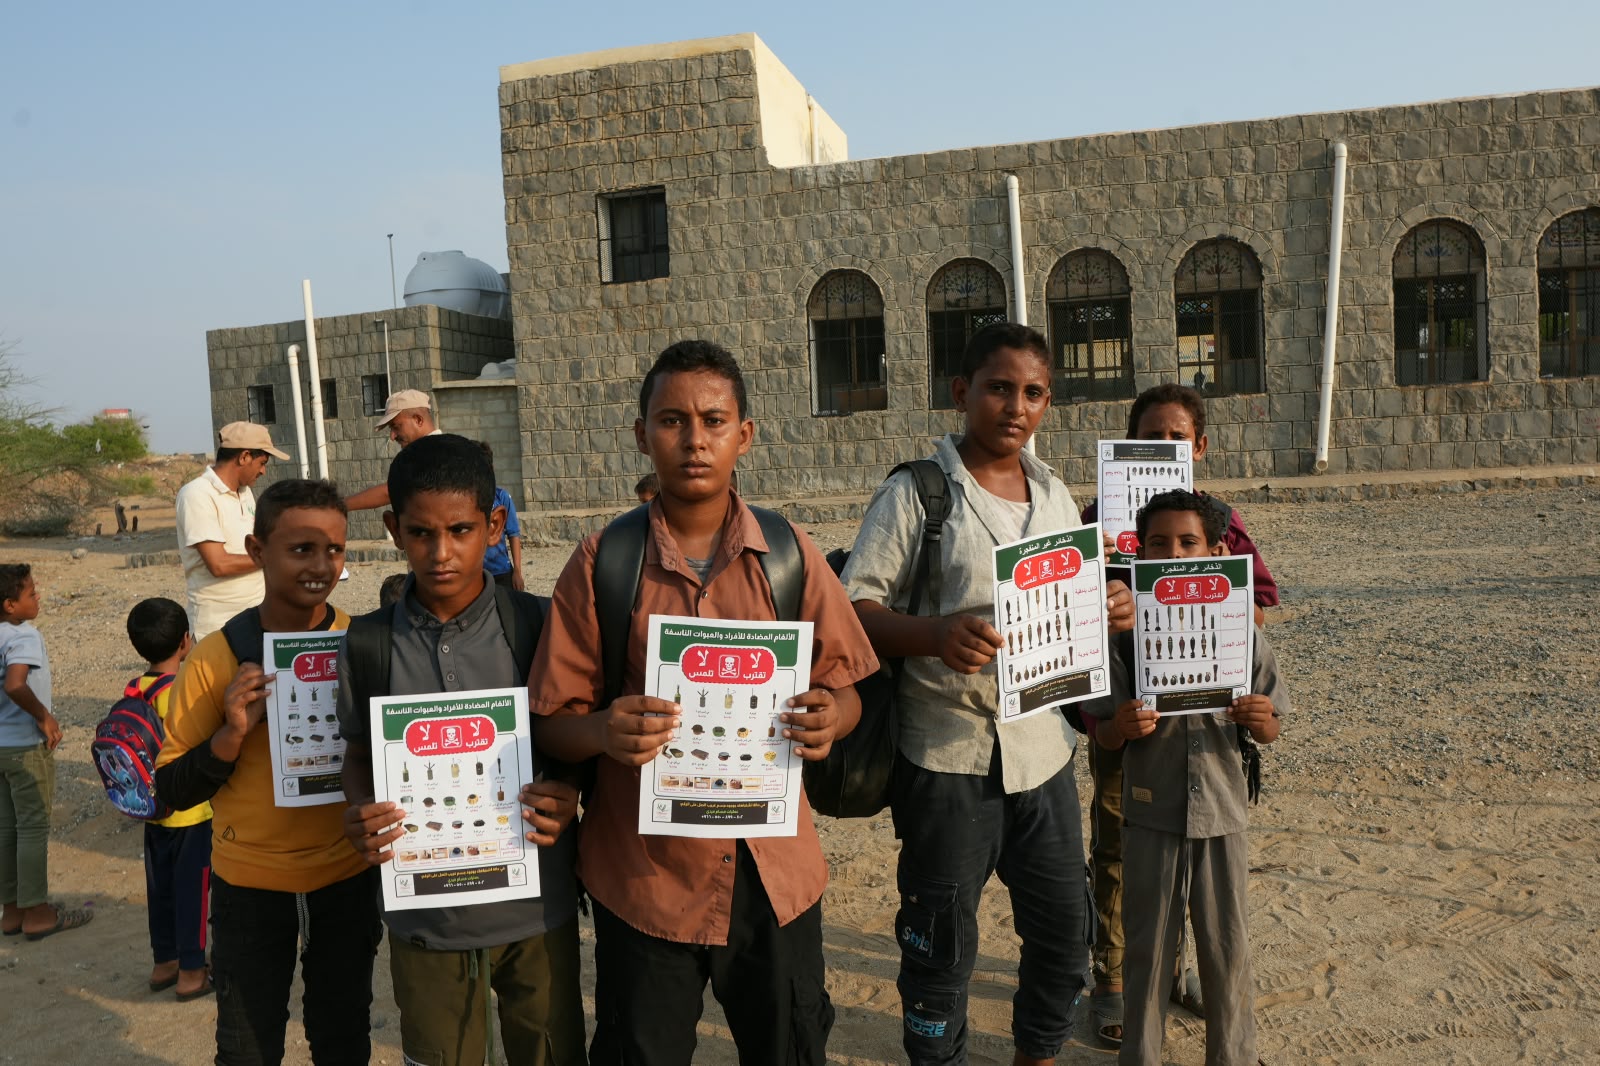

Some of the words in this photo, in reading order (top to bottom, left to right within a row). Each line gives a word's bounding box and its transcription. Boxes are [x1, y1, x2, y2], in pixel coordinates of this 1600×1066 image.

[1042, 540, 1051, 549] غير
[1054, 535, 1073, 547] الذخائر
[1019, 543, 1040, 555] المنفجرة
[1061, 552, 1070, 566] لا
[1024, 561, 1032, 576] لا
[1057, 567, 1076, 576] تقترب
[1161, 565, 1187, 573] المنفجرة
[1188, 564, 1199, 572] غير
[1020, 576, 1038, 587] تلمس
[1166, 580, 1176, 593] لا
[1209, 578, 1219, 591] لا
[1161, 594, 1181, 602] تلمس
[664, 628, 692, 636] الناسفة
[693, 631, 723, 640] والعبوات
[724, 632, 745, 641] للأفراد
[746, 633, 773, 641] المضادة
[773, 633, 796, 643] الألغام
[305, 656, 315, 670] لا
[697, 649, 709, 667] لا
[750, 651, 762, 669] لا
[300, 671, 321, 679] تلمس
[689, 669, 714, 678] تلمس
[743, 671, 766, 680] تقترب
[413, 705, 442, 714] والعبوات
[443, 703, 464, 713] للأفراد
[464, 701, 490, 710] المضادة
[491, 699, 512, 710] الألغام
[386, 707, 412, 715] الناسفة
[419, 723, 431, 741] لا
[470, 720, 481, 737] لا
[413, 742, 438, 753] تلمس
[465, 738, 488, 748] تقترب
